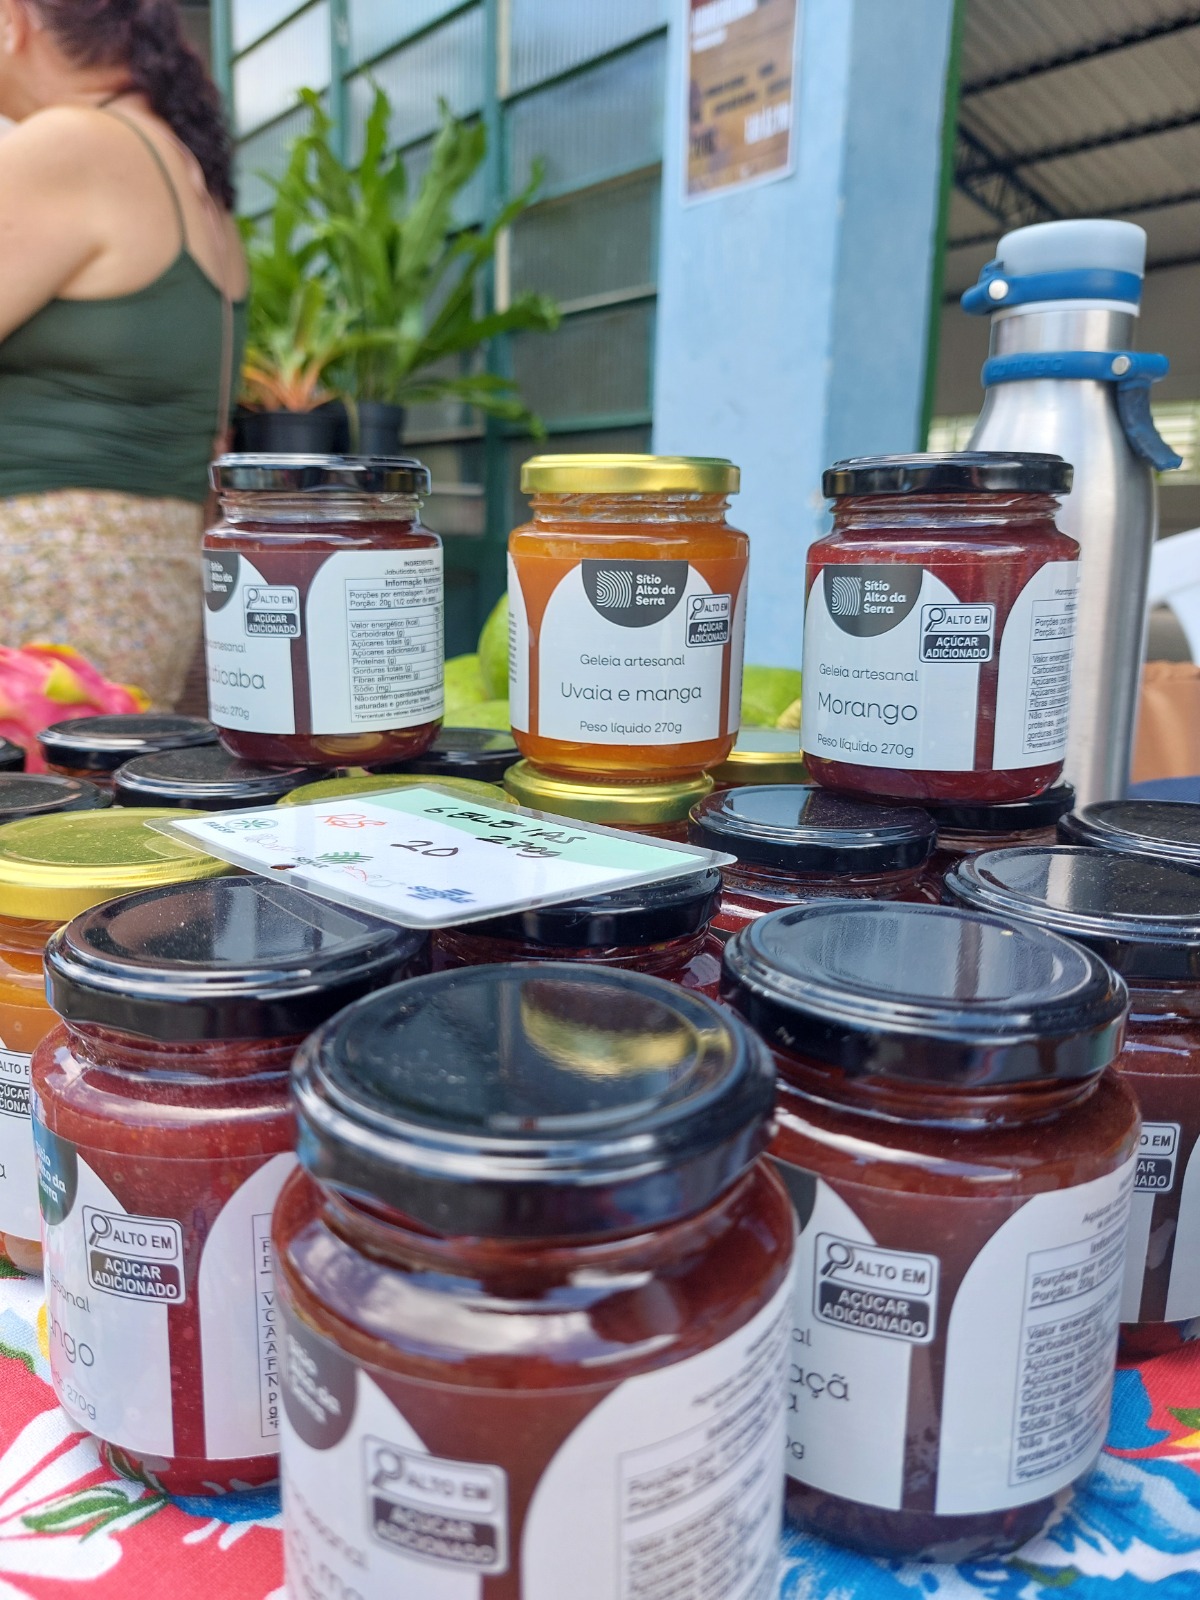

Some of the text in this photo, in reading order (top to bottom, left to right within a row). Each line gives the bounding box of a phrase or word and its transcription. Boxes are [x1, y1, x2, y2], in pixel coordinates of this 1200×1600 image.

[636, 574, 662, 584] Sítio
[636, 586, 676, 595] Alto da
[864, 580, 890, 591] Sítio
[260, 595, 294, 604] ALTO EM
[636, 596, 666, 606] Serra
[864, 592, 906, 603] Alto da
[704, 602, 728, 612] ALTO EM
[864, 604, 894, 614] Serra
[254, 612, 288, 624] AÇÚCAR
[946, 615, 988, 625] ALTO EM
[249, 624, 296, 634] ADICIONADO
[352, 630, 395, 638] Carboidratos
[698, 622, 724, 634] AÇÚCAR
[690, 631, 727, 643] ADICIONADO
[936, 635, 979, 648] AÇÚCAR
[352, 641, 384, 650] Açúcares
[352, 649, 384, 658] Açúcares
[925, 648, 988, 659] ADICIONADO
[580, 654, 686, 666] Geleia artesanal
[819, 663, 919, 682] Geleia artesanal
[354, 676, 376, 684] Fibras
[561, 682, 702, 704] Uvaia e manga
[354, 702, 388, 710] saturadas
[818, 692, 918, 725] Morango
[580, 721, 682, 735] Peso líquido 270g
[818, 734, 914, 758] Peso líquido 270g
[390, 840, 459, 857] 20
[1152, 1135, 1171, 1146] EM
[52, 1174, 66, 1194] da
[112, 1230, 172, 1250] ALTO EM
[105, 1258, 162, 1280] AÇÚCAR
[854, 1260, 926, 1284] ALTO EM
[94, 1270, 178, 1297] ADICIONADO
[838, 1289, 911, 1316] AÇÚCAR
[822, 1302, 926, 1337] ADICIONADO
